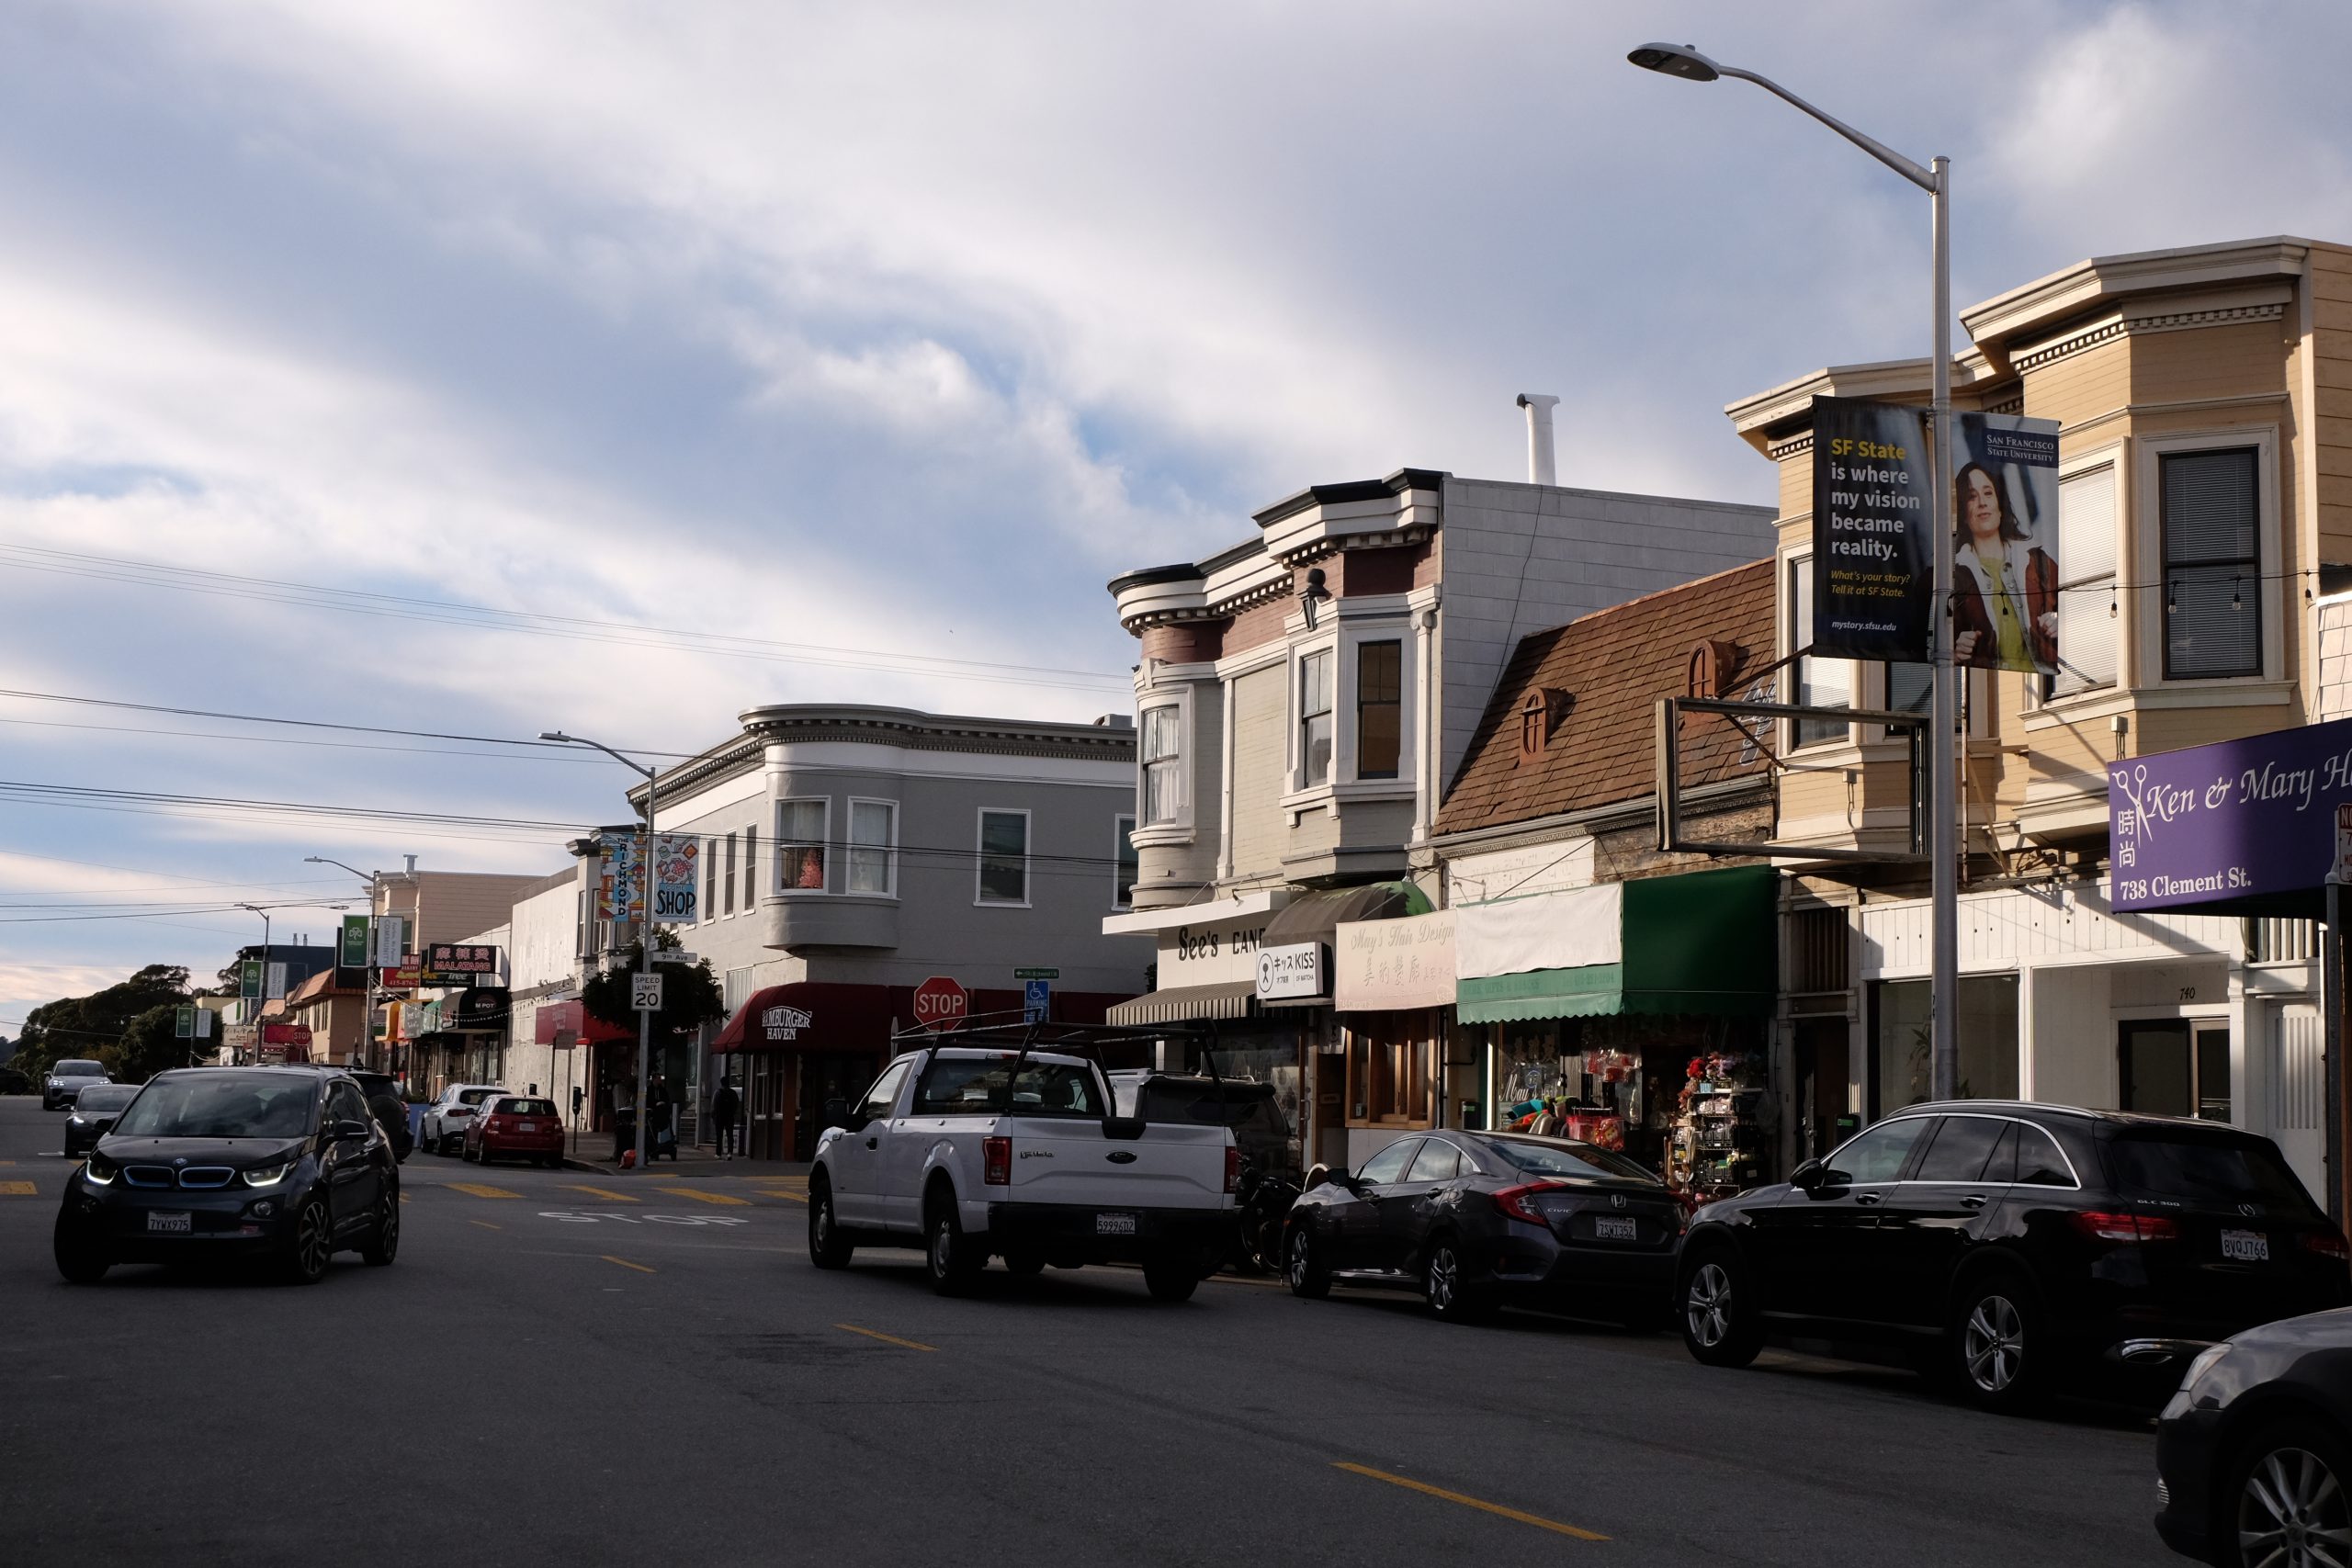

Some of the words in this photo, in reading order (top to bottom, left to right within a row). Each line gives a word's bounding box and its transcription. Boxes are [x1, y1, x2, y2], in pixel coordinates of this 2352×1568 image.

[1831, 438, 1853, 456] SF
[1858, 440, 1906, 459] State
[1831, 462, 1846, 480] is
[1851, 465, 1908, 484] where
[1832, 491, 1860, 510] my
[1864, 490, 1920, 510] vision
[1831, 513, 1905, 533] became
[1831, 538, 1898, 561] reality.
[1830, 570, 1860, 581] What's
[1861, 572, 1883, 583] your
[1883, 573, 1911, 584] story?
[1831, 584, 1847, 595] Tell
[1848, 585, 1853, 595] it
[1855, 587, 1866, 595] at
[1868, 586, 1879, 596] SF
[1881, 587, 1905, 598] State.
[1832, 619, 1897, 632] mystory.sfsu.edu
[2146, 784, 2196, 822] Ken
[2204, 776, 2233, 809] &
[2239, 761, 2315, 812] Mary
[2118, 808, 2135, 868] 時尚
[617, 843, 628, 916] RICHMOND
[2120, 880, 2147, 901] 738
[2152, 871, 2224, 897] Clement
[2228, 866, 2253, 889] St.
[655, 889, 696, 916] SHOP
[1179, 926, 1218, 961] See's
[1351, 926, 1383, 954] May's
[1388, 925, 1413, 947] Hair
[1418, 920, 1454, 945] Design
[434, 961, 491, 971] MALATANG
[1274, 955, 1294, 972] キッス
[1295, 952, 1314, 970] KISS
[635, 992, 659, 1007] 20
[1027, 998, 1048, 1007] PARKING
[2179, 987, 2196, 1000] 740
[918, 994, 963, 1014] STOP
[762, 1008, 810, 1028] HAMBURGER
[294, 1032, 311, 1040] STOP
[766, 1028, 797, 1040] HAVEN
[151, 1219, 189, 1231] 7YWX975
[537, 1211, 750, 1227] STOP
[2223, 1238, 2267, 1257] 8VQJ766
